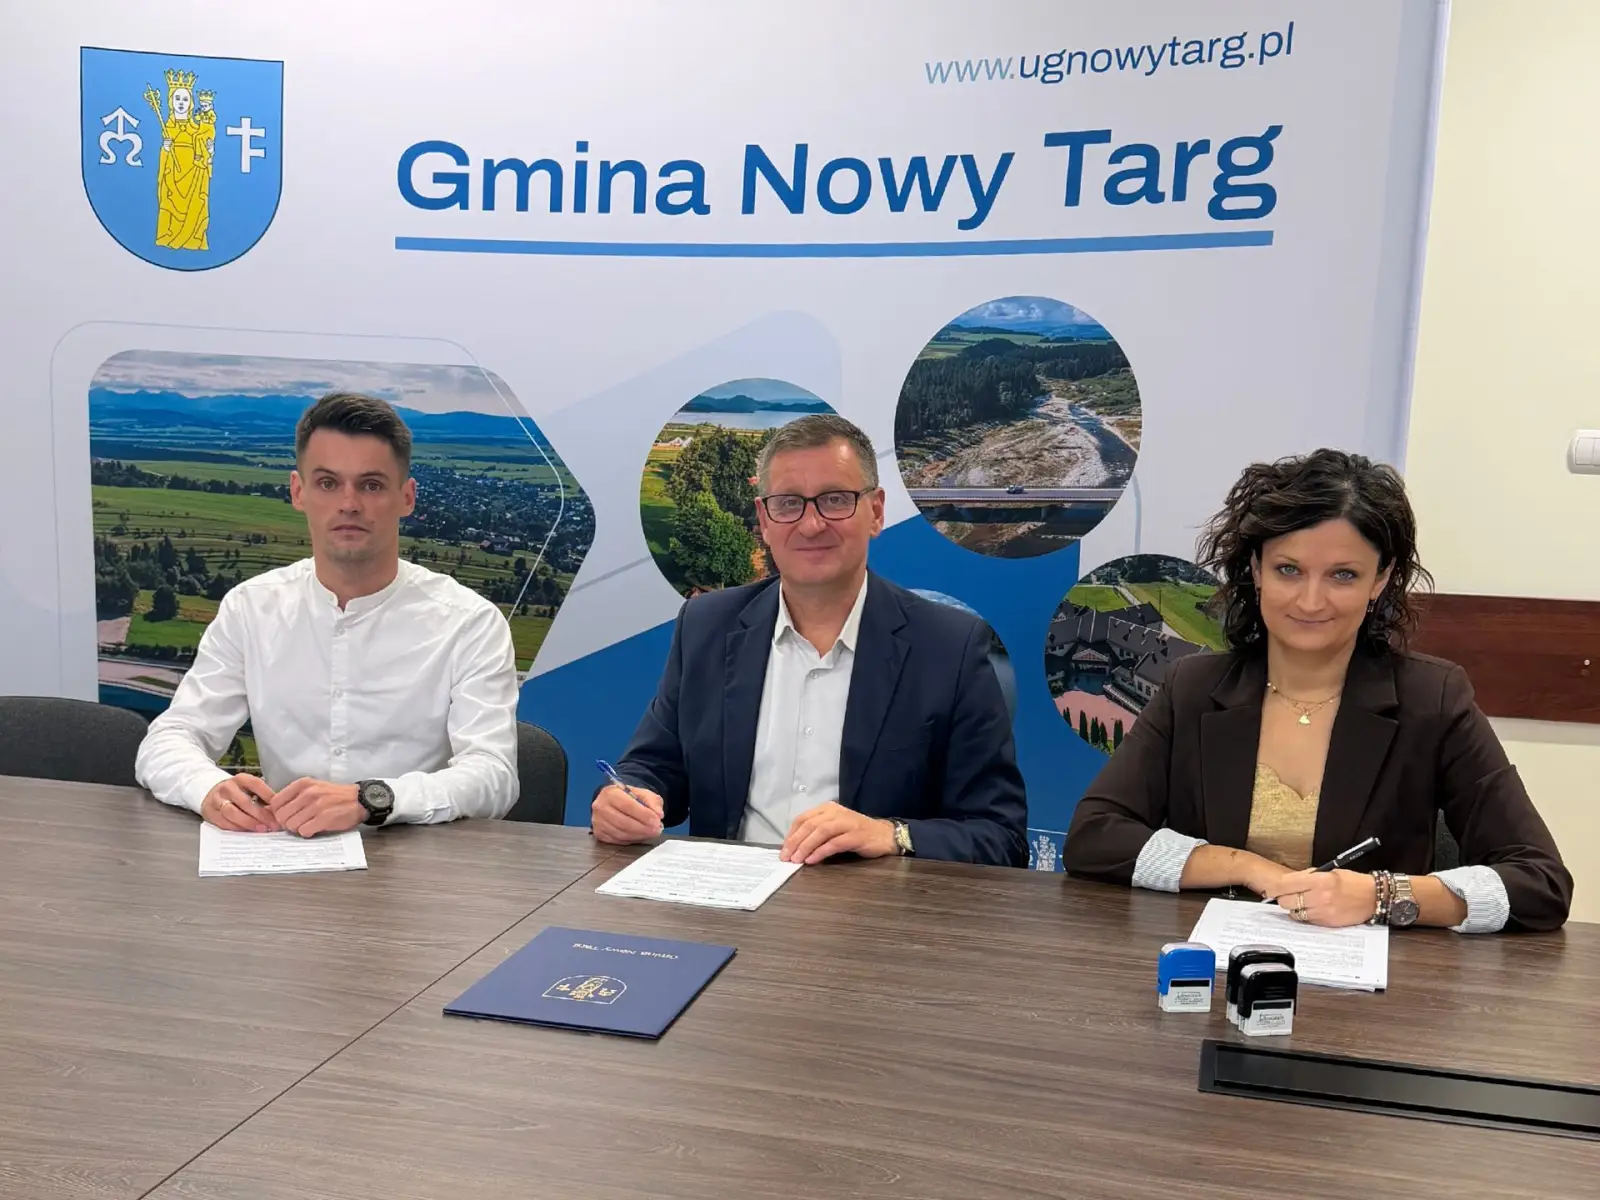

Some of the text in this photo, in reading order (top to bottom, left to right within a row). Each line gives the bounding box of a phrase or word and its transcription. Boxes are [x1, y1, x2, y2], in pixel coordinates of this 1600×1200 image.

[925, 22, 1294, 84] www.ugnowytarg.pl
[396, 125, 1283, 231] Gmina Nowy Targ
